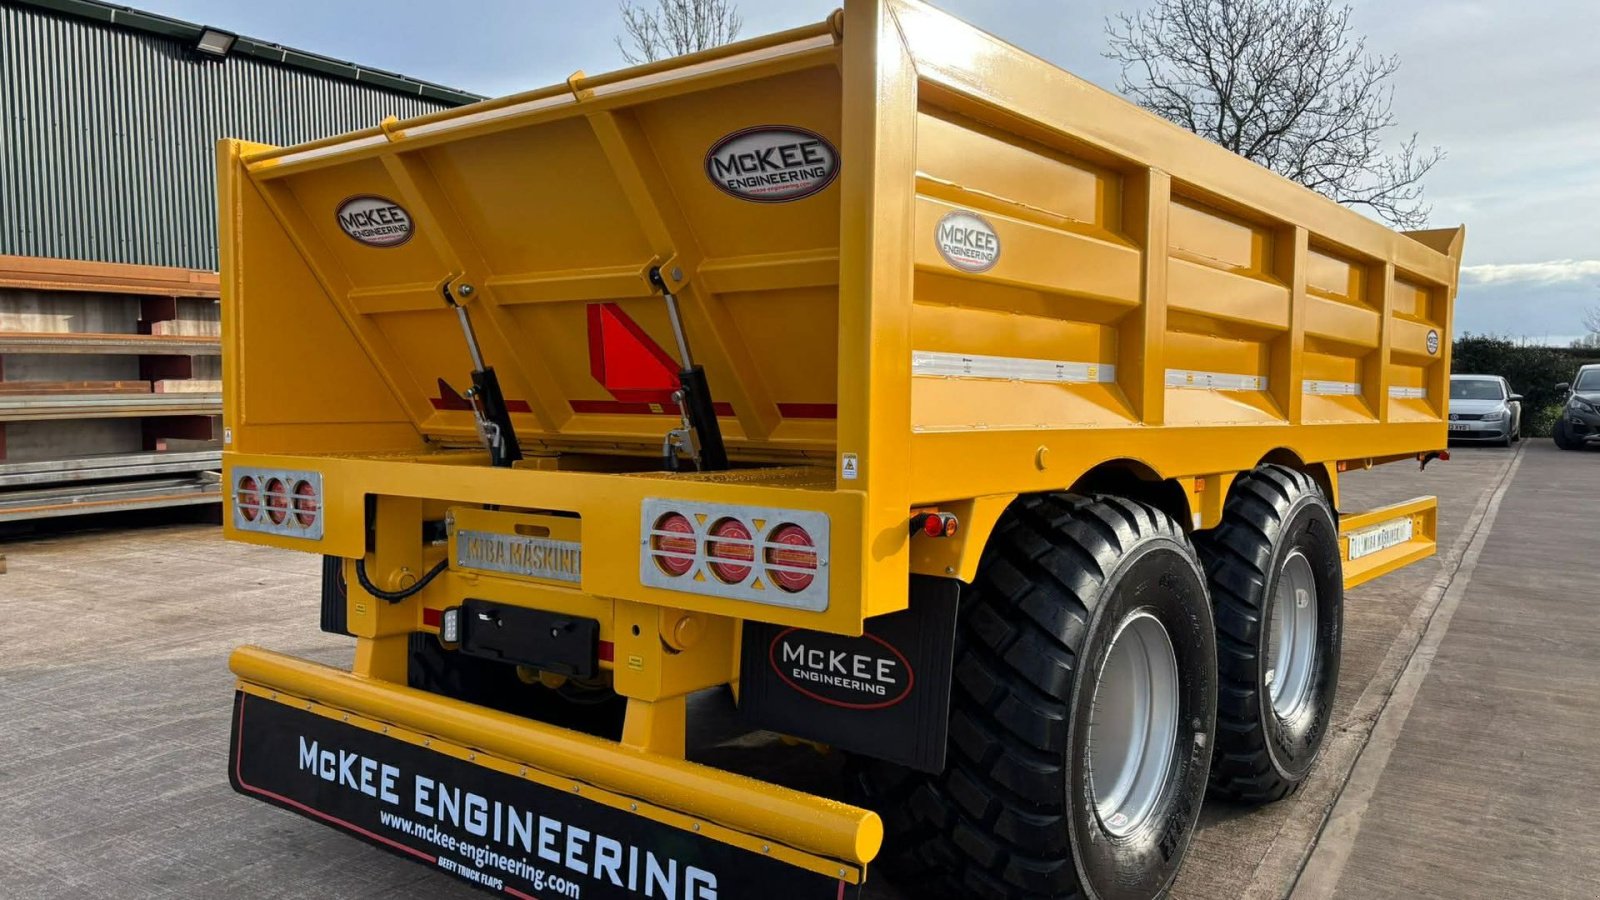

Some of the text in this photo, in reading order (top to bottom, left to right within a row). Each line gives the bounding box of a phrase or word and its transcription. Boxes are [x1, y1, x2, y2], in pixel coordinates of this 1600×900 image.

[727, 167, 826, 190] ENGINEERING
[353, 224, 408, 238] ENGINEERING
[943, 244, 993, 262] ENGINEERING
[466, 537, 582, 575] MIBA MASKINE
[792, 668, 886, 696] ENGINEERING
[415, 774, 718, 900] ENGINEERING
[380, 810, 580, 900] www.mckee-engineering.com
[438, 855, 503, 891] BEEFY TRUCK FLAPS
